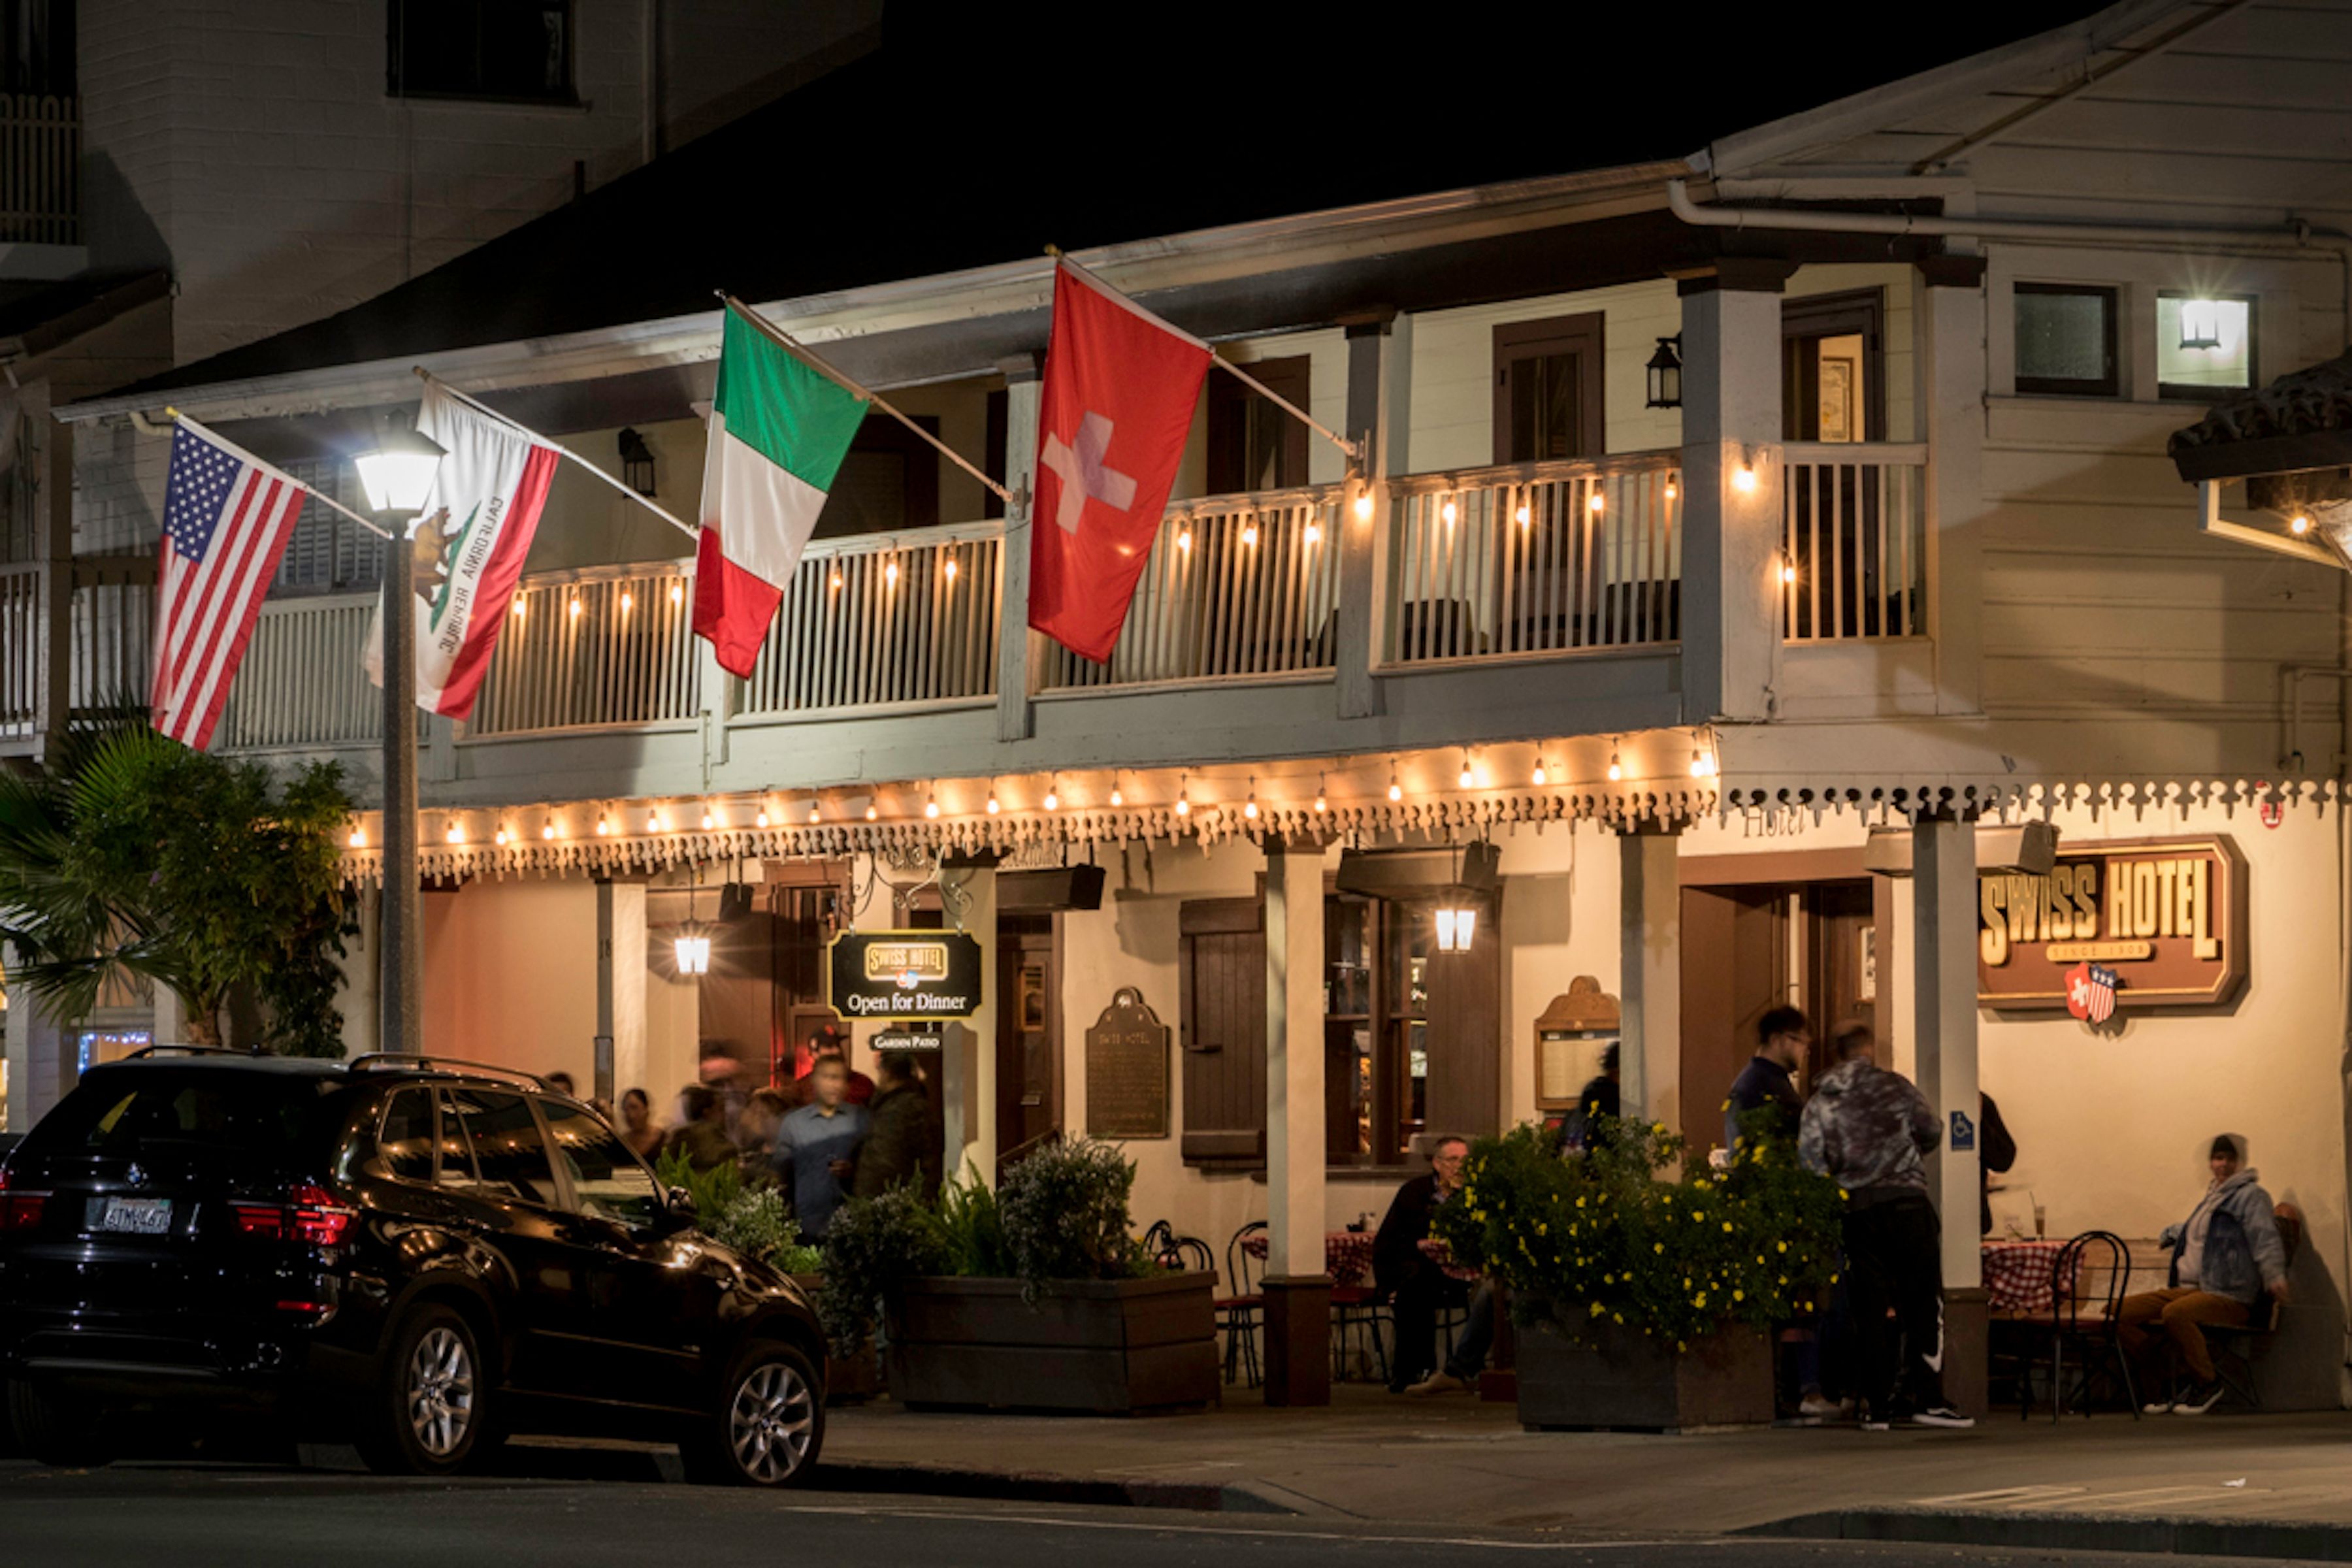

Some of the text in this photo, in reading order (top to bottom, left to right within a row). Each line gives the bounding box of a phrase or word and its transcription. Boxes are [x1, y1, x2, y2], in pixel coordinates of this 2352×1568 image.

[1980, 858, 2217, 966] SWISS HOTEL
[870, 948, 942, 971] SWISS HOTEL
[847, 992, 966, 1016] Open for Dinner
